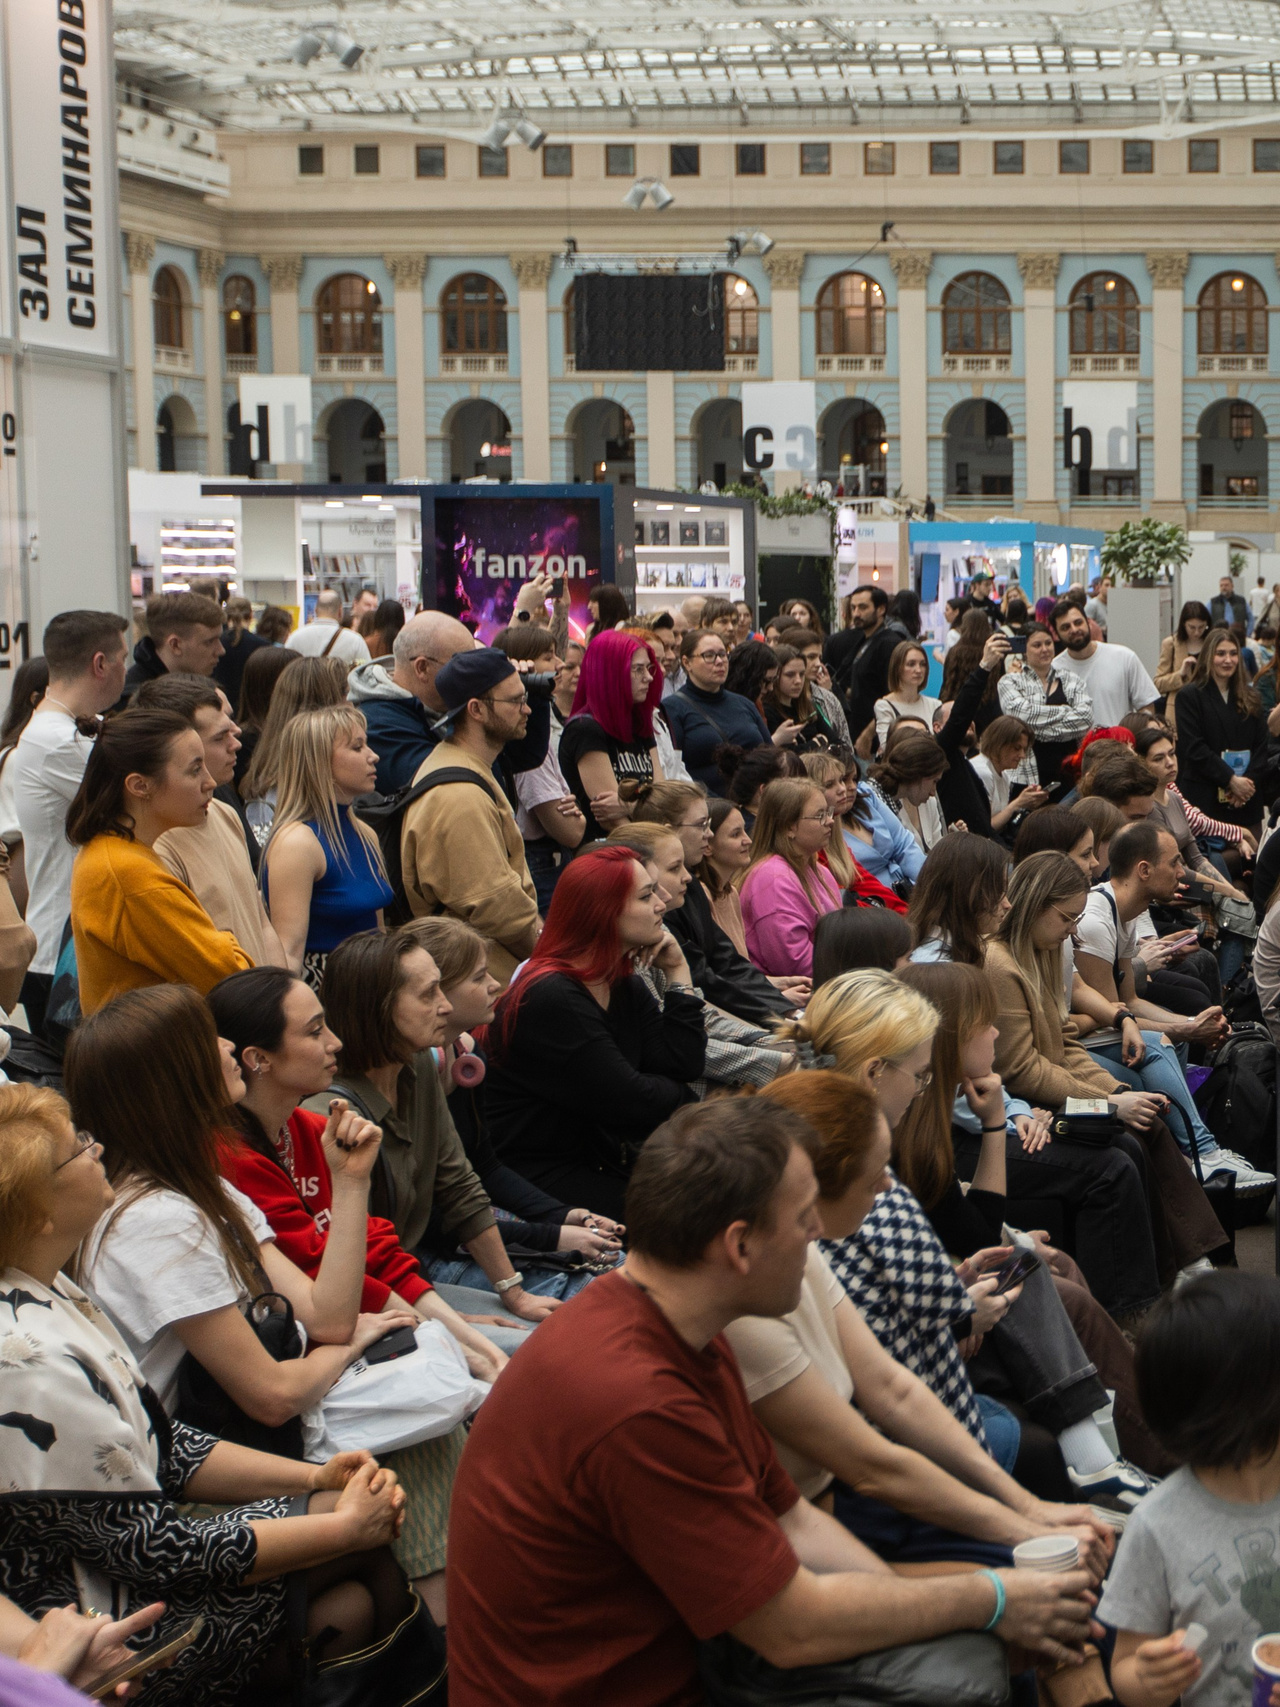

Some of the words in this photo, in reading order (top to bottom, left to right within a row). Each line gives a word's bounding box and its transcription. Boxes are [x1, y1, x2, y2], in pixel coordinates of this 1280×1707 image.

[56, 0, 96, 330] СЕМИНАРОВ
[16, 203, 49, 322] ЗАЛ
[472, 547, 587, 579] fanzon
